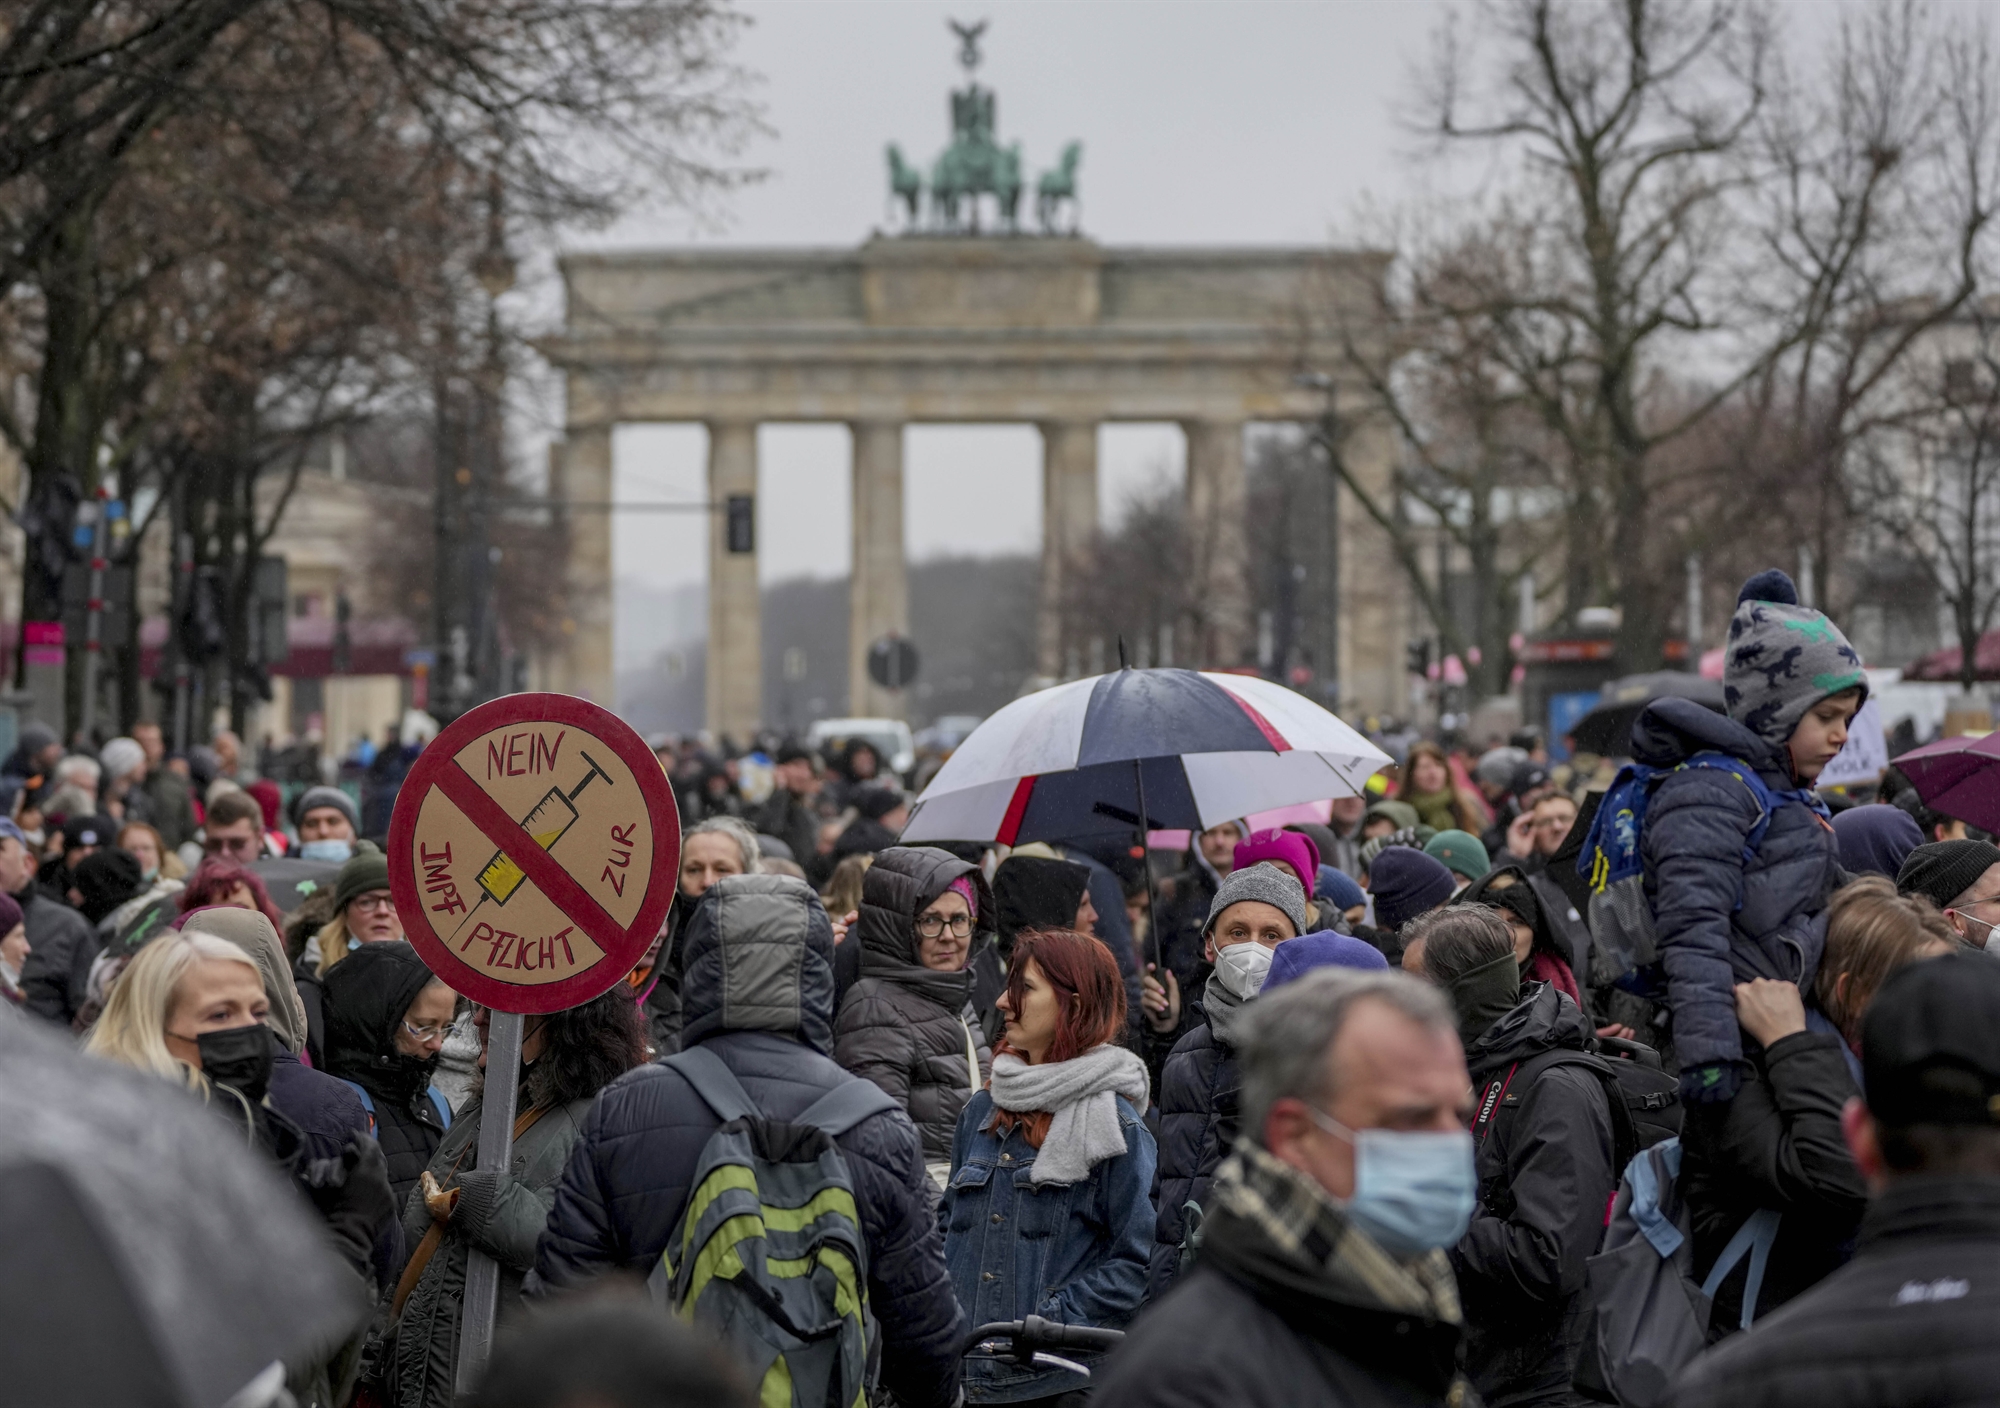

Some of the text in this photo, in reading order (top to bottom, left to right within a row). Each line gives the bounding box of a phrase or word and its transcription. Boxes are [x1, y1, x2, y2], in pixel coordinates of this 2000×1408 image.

[487, 730, 566, 780] NEIN
[420, 841, 467, 916] IMPF
[601, 822, 637, 898] ZUR
[460, 922, 575, 970] PFLICHT
[1479, 1081, 1501, 1122] Canon
